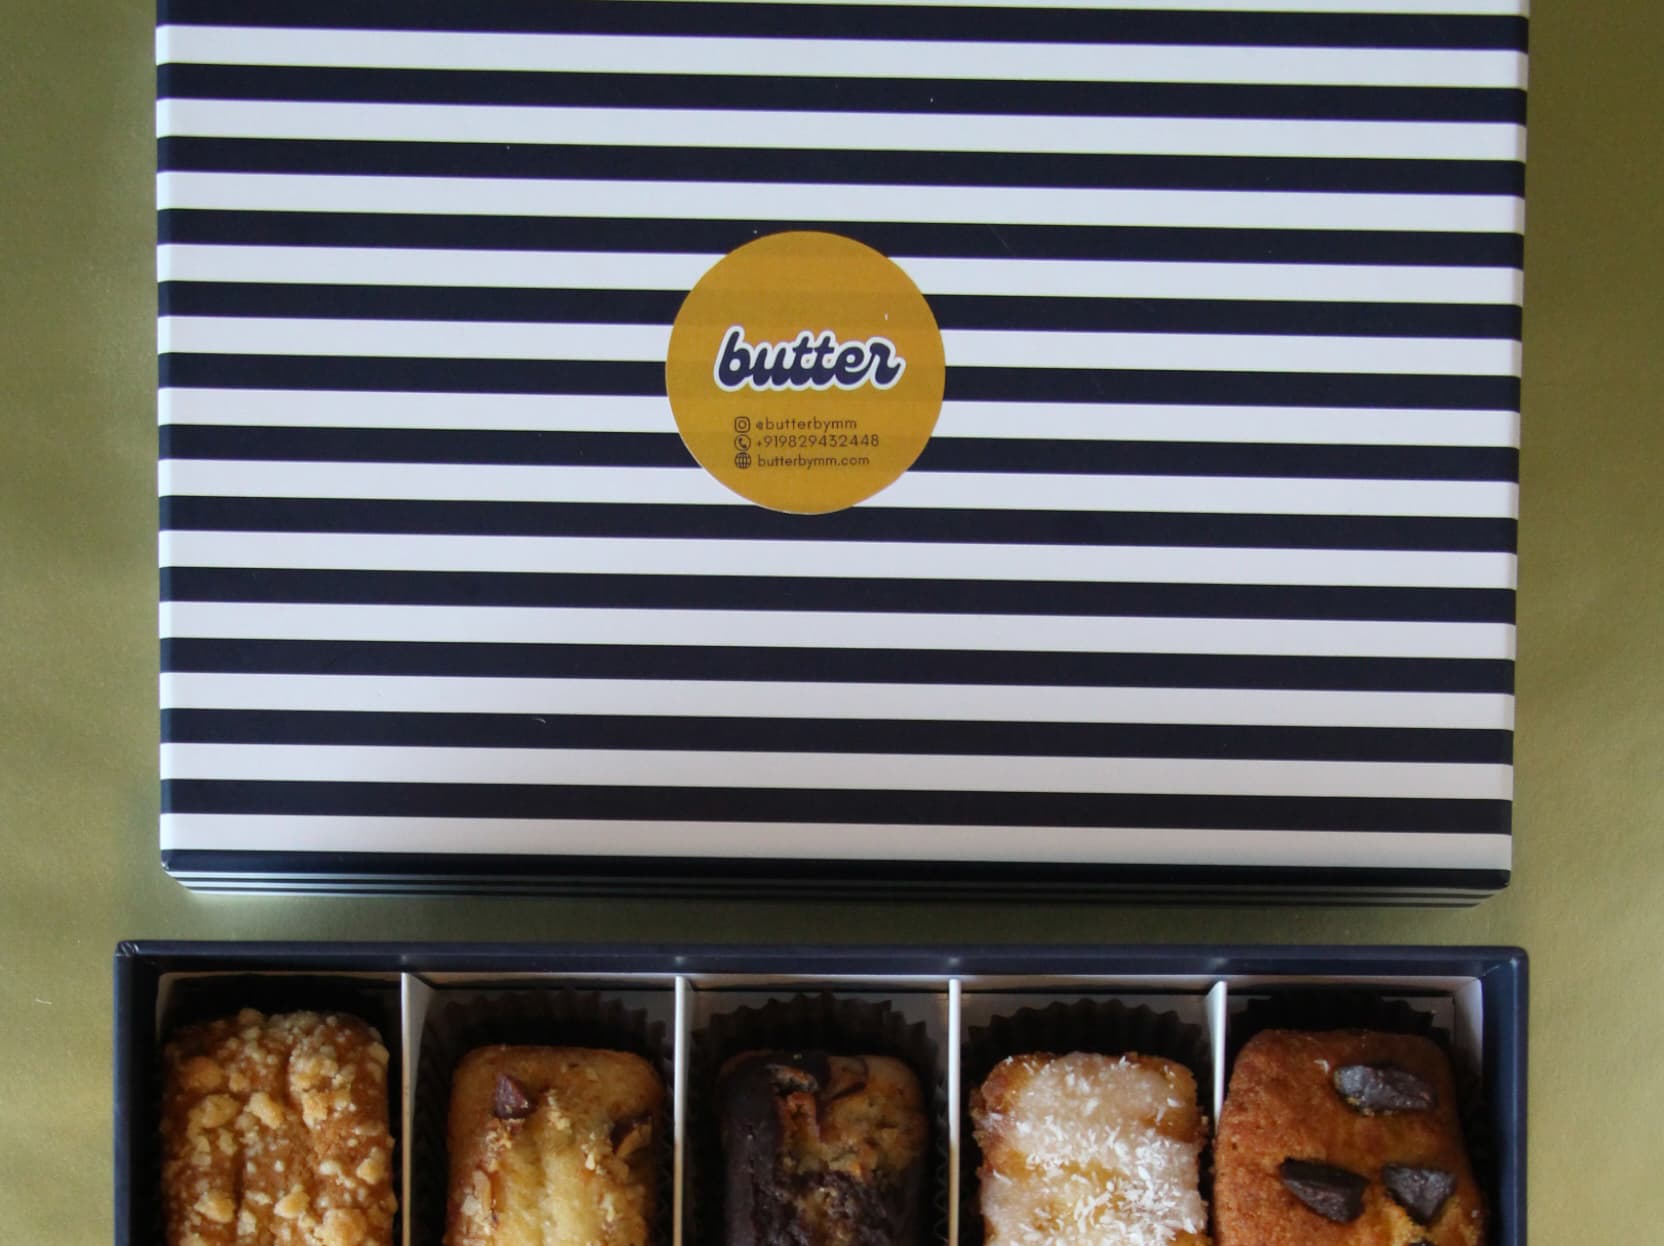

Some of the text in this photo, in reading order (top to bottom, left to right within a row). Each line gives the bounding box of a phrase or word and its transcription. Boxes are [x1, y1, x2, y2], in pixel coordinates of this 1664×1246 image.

[715, 327, 904, 390] butter
[756, 416, 857, 433] @butterbymm
[757, 434, 879, 448] +919829432448
[757, 454, 870, 470] butterbymm.com
